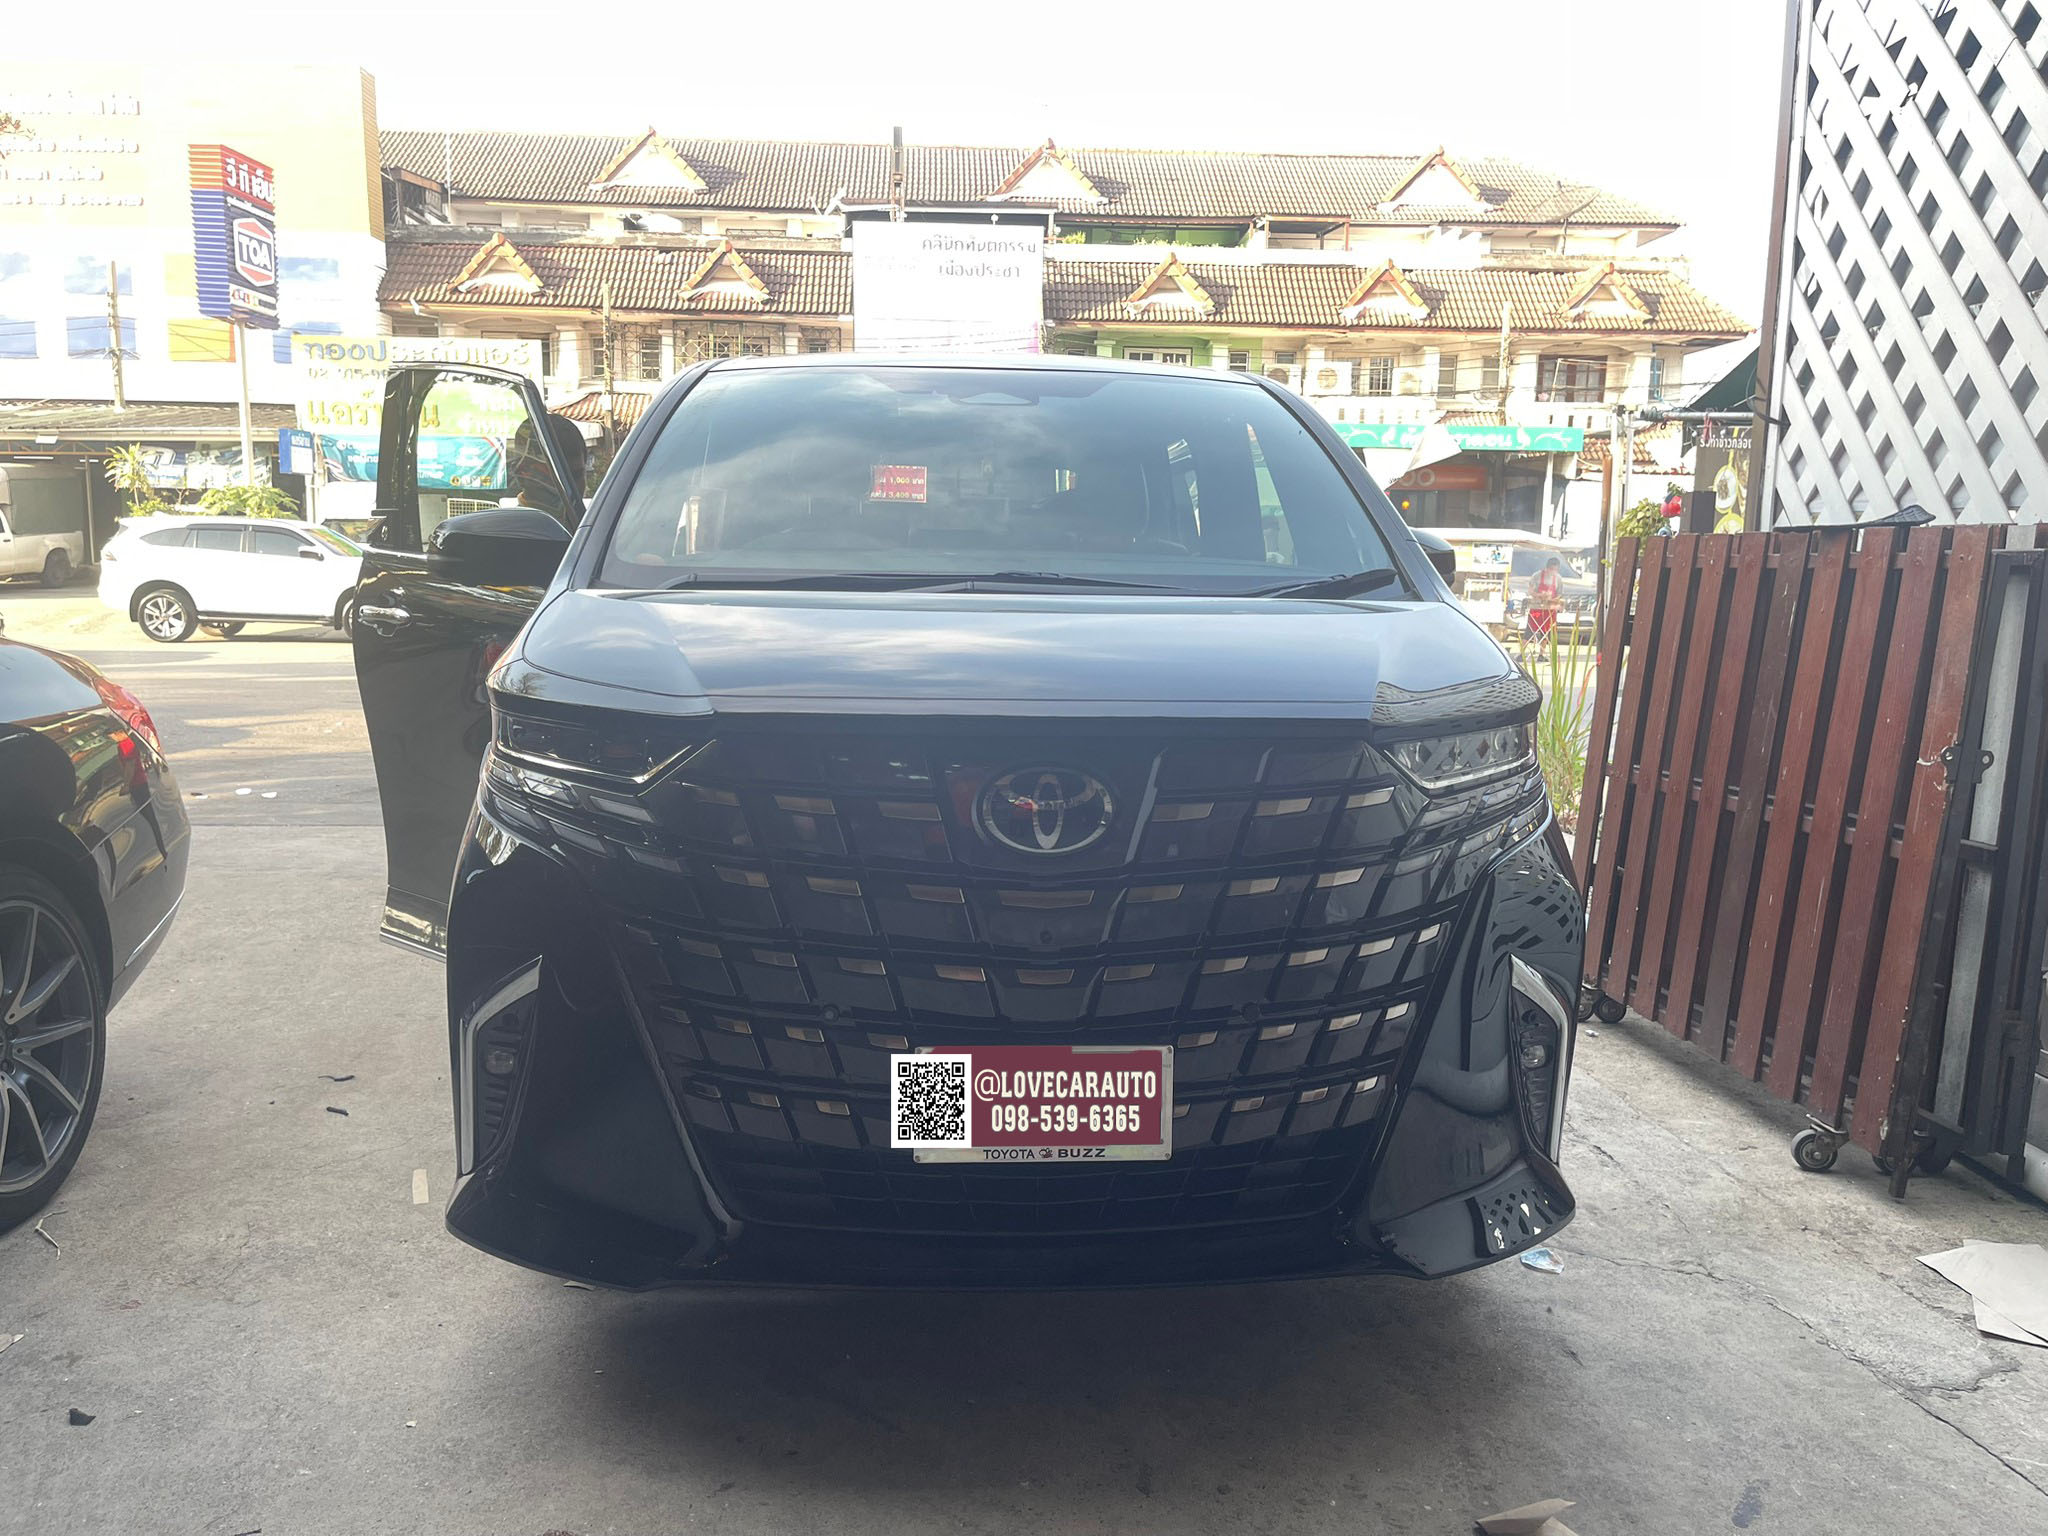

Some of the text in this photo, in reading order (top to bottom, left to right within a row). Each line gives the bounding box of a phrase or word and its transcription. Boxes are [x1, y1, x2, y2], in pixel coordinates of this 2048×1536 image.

[239, 236, 272, 270] TOA
[983, 1148, 1106, 1160] TOYOTA BUZZ
